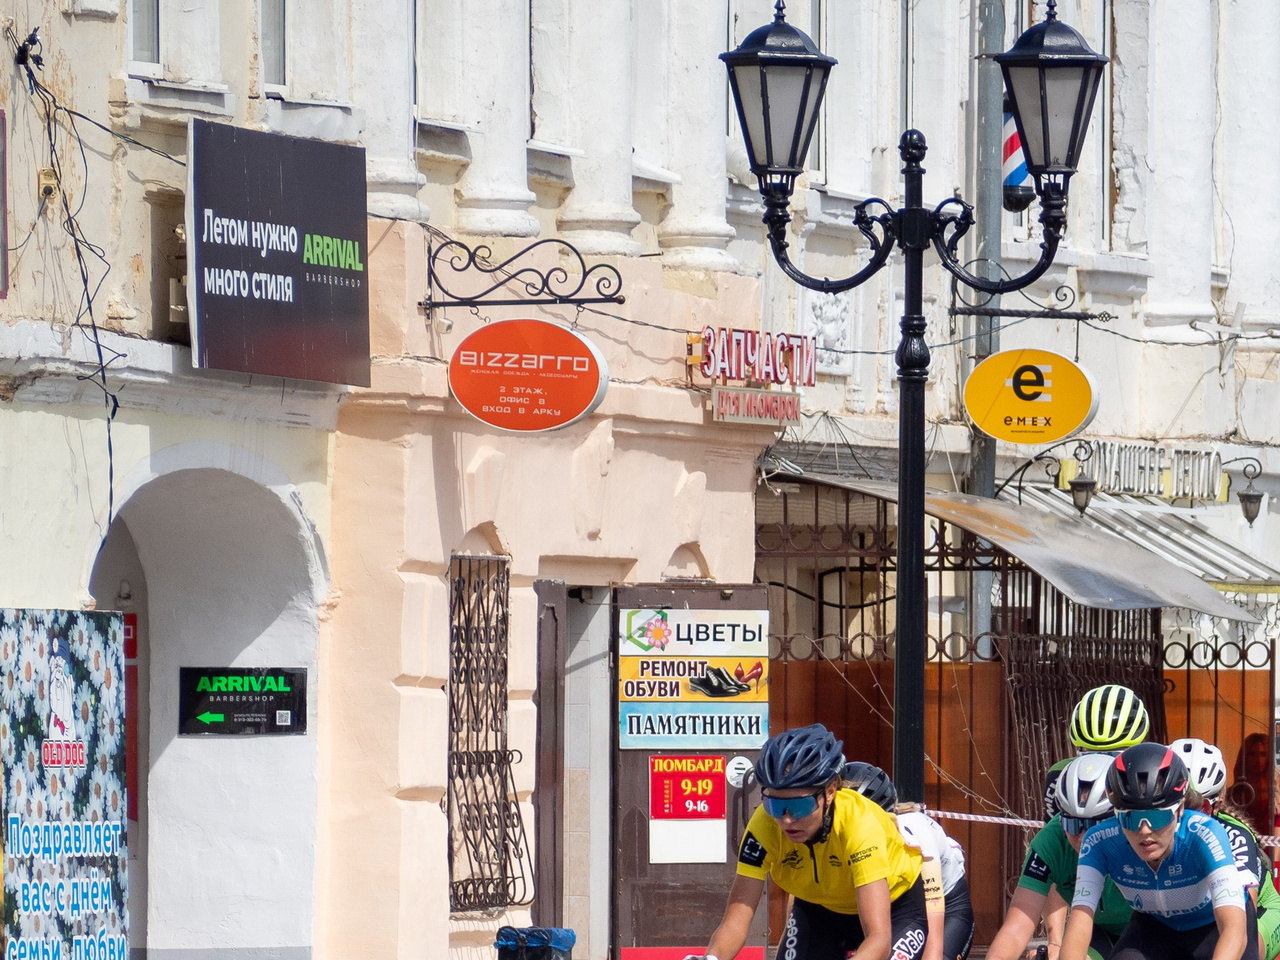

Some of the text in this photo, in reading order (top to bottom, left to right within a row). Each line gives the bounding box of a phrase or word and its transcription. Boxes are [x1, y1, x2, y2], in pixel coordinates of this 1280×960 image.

[203, 208, 298, 258] Летом нужно
[303, 233, 364, 272] ARRIVAL
[204, 267, 293, 303] много стиля
[305, 272, 361, 288] BARBERSHOP
[701, 325, 816, 387] ЗАПЧАСТИ
[500, 385, 506, 393] 2
[499, 396, 530, 404] ОФИС
[717, 390, 799, 424] для иномарок
[482, 405, 511, 414] ВХОД
[533, 407, 561, 416] АРКУ
[676, 623, 762, 645] ЦВЕТЫ
[640, 660, 708, 677] РЕМОНТ
[196, 675, 291, 692] ARRIVAL
[624, 681, 680, 697] ОБУВИ
[627, 715, 761, 735] ПАМЯТНИКИ
[42, 741, 85, 767] OLD DOG
[653, 758, 724, 773] ЛОМБАРД
[681, 778, 713, 795] 9-19
[685, 799, 709, 813] 9-16
[8, 815, 121, 865] Поздравляет
[1220, 822, 1249, 870] USSIA
[21, 869, 112, 919] вас с днём
